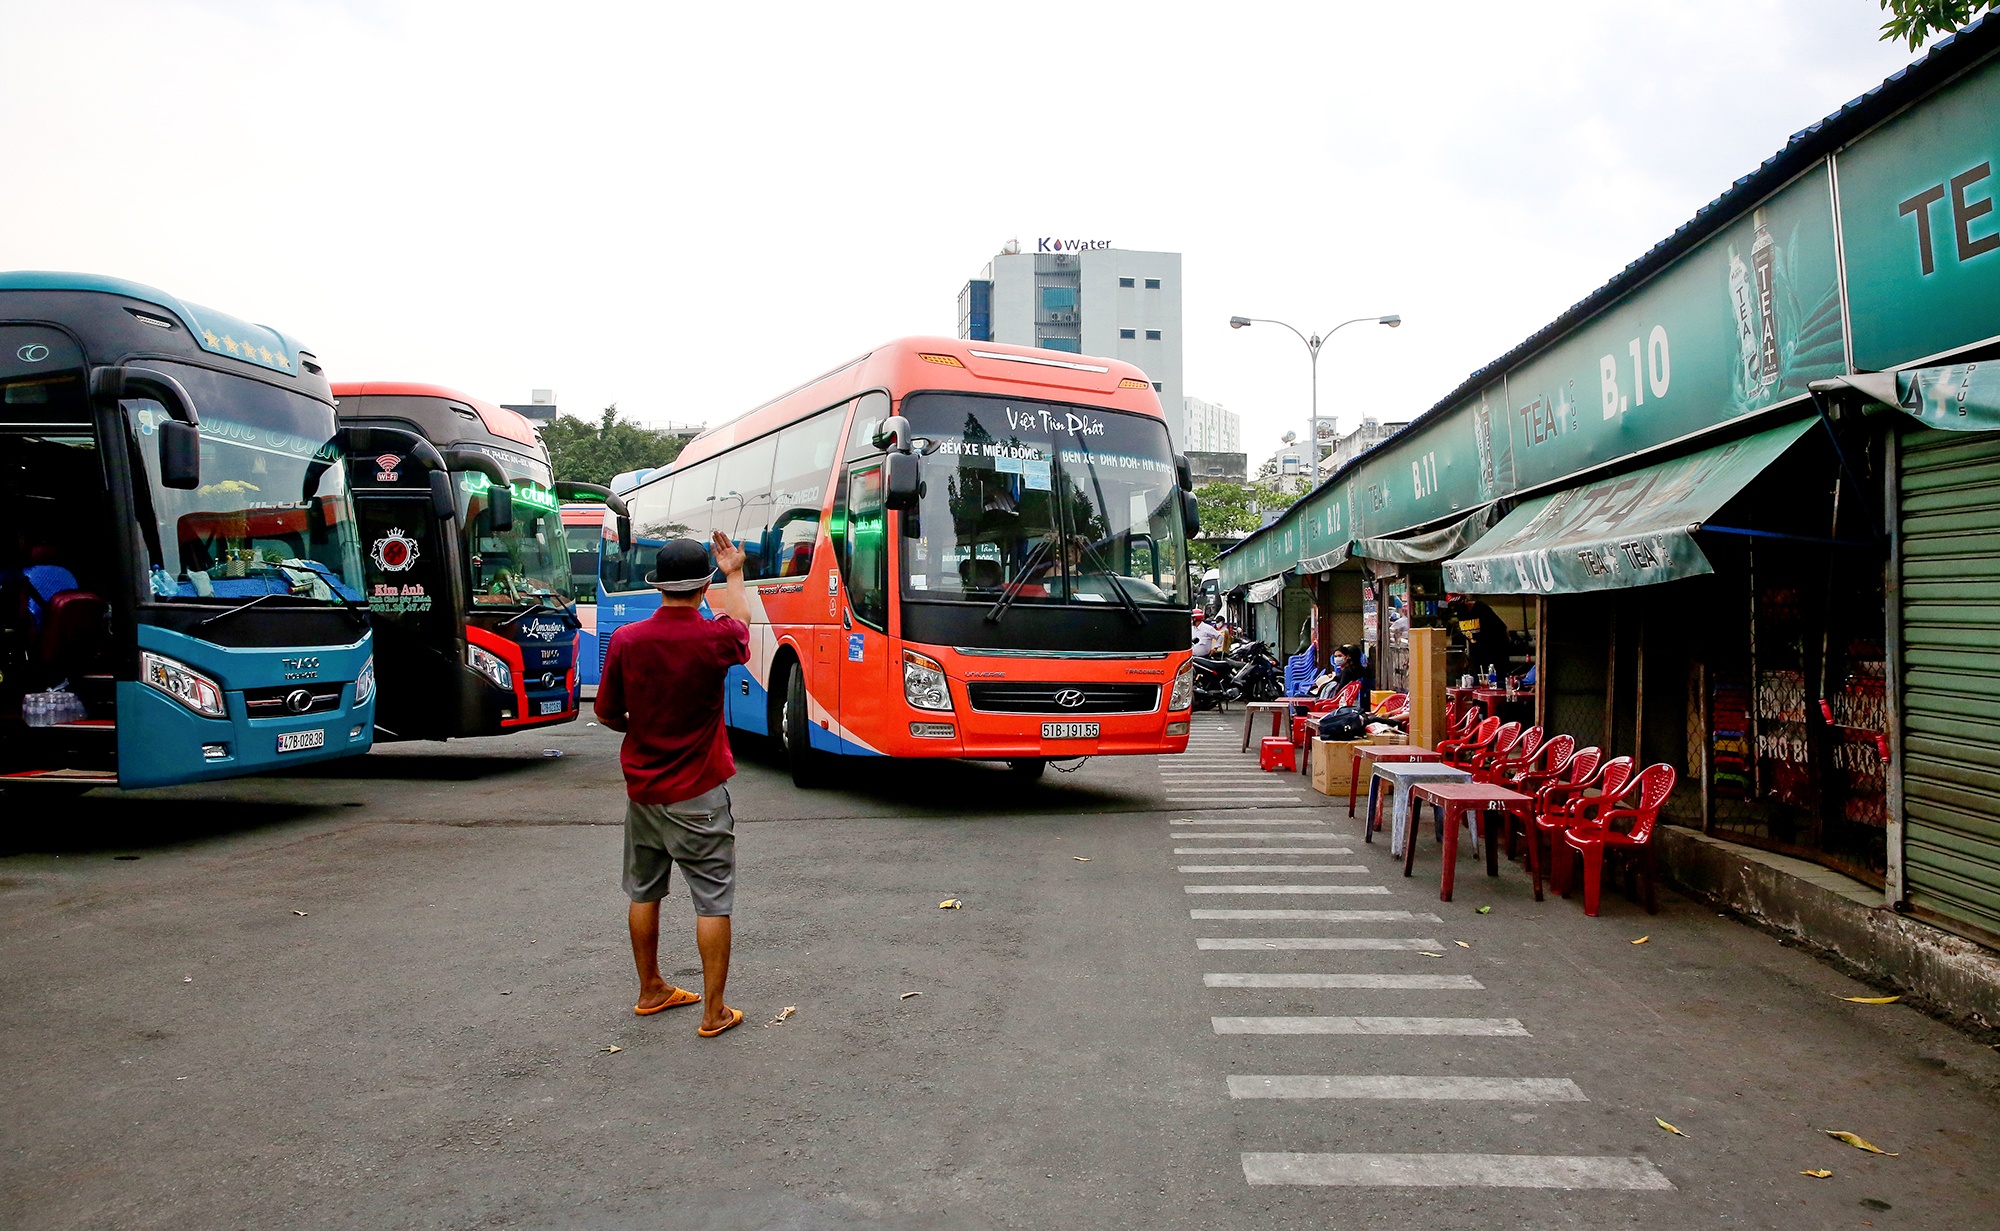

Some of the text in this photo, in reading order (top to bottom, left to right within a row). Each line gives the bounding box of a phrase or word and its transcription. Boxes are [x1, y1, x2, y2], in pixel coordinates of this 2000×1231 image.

[1600, 325, 1670, 421] B.10
[940, 437, 962, 455] BẾN
[964, 443, 979, 456] XE
[1412, 451, 1438, 500] B.11
[1327, 502, 1341, 535] B.12
[1514, 547, 1555, 592] B.10
[374, 584, 425, 596] Kim Anh
[526, 618, 562, 639] Limousine
[282, 656, 320, 670] THACO
[283, 731, 323, 750] 47B-028.38
[1042, 723, 1099, 738] 51B-191.55
